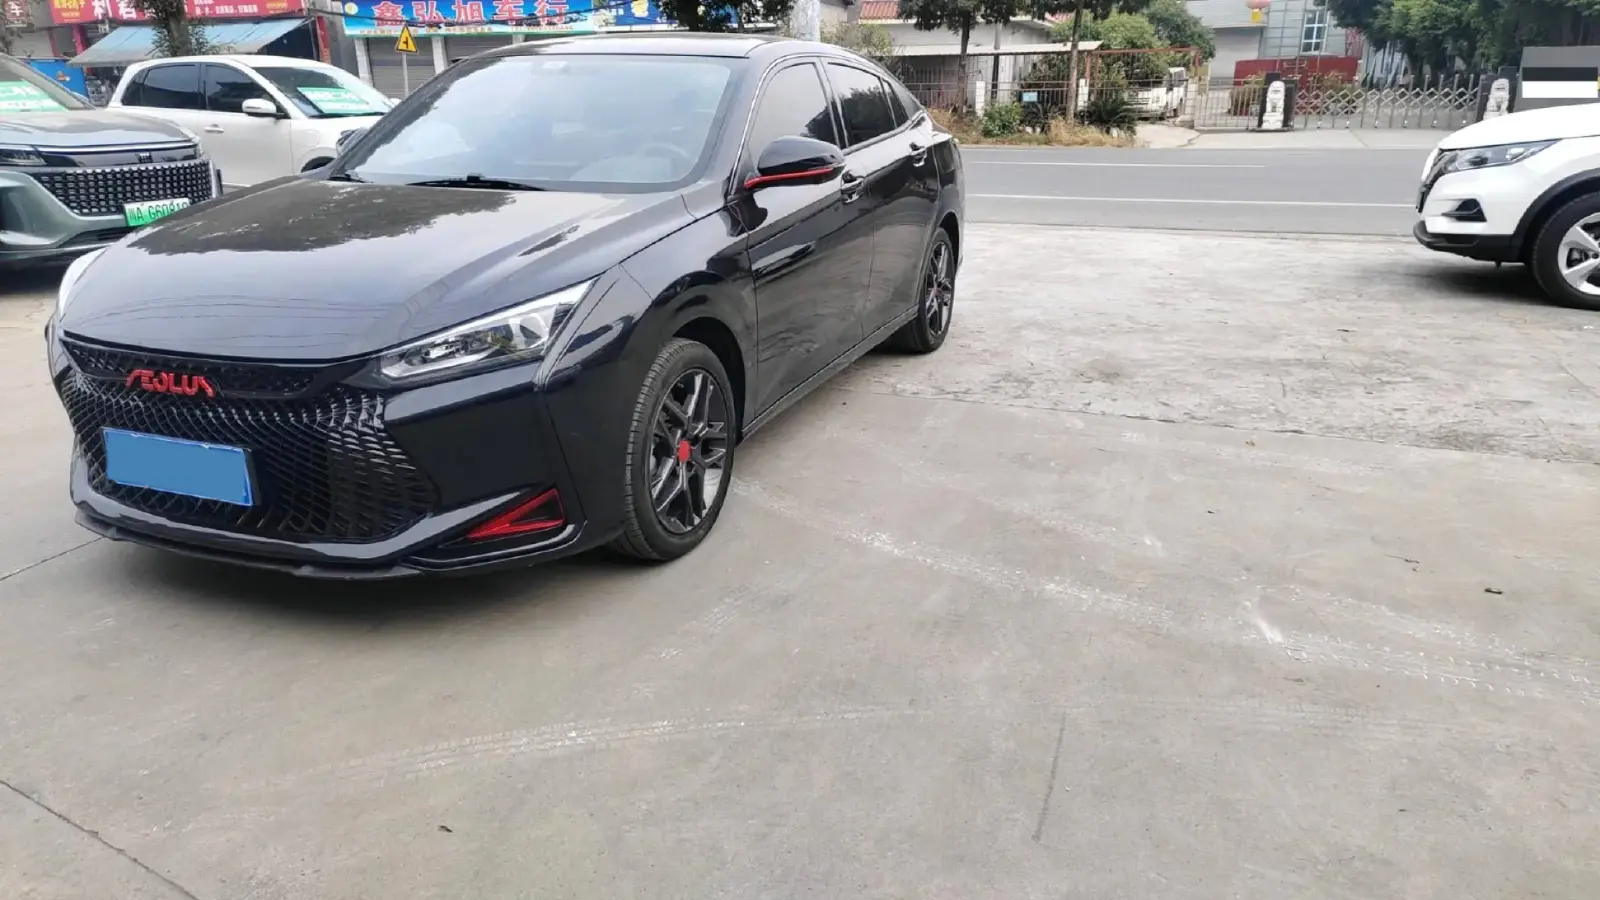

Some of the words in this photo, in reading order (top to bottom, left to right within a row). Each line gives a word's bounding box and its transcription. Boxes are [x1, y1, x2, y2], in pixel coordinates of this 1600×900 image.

[371, 0, 570, 26] 鑫弘旭车行
